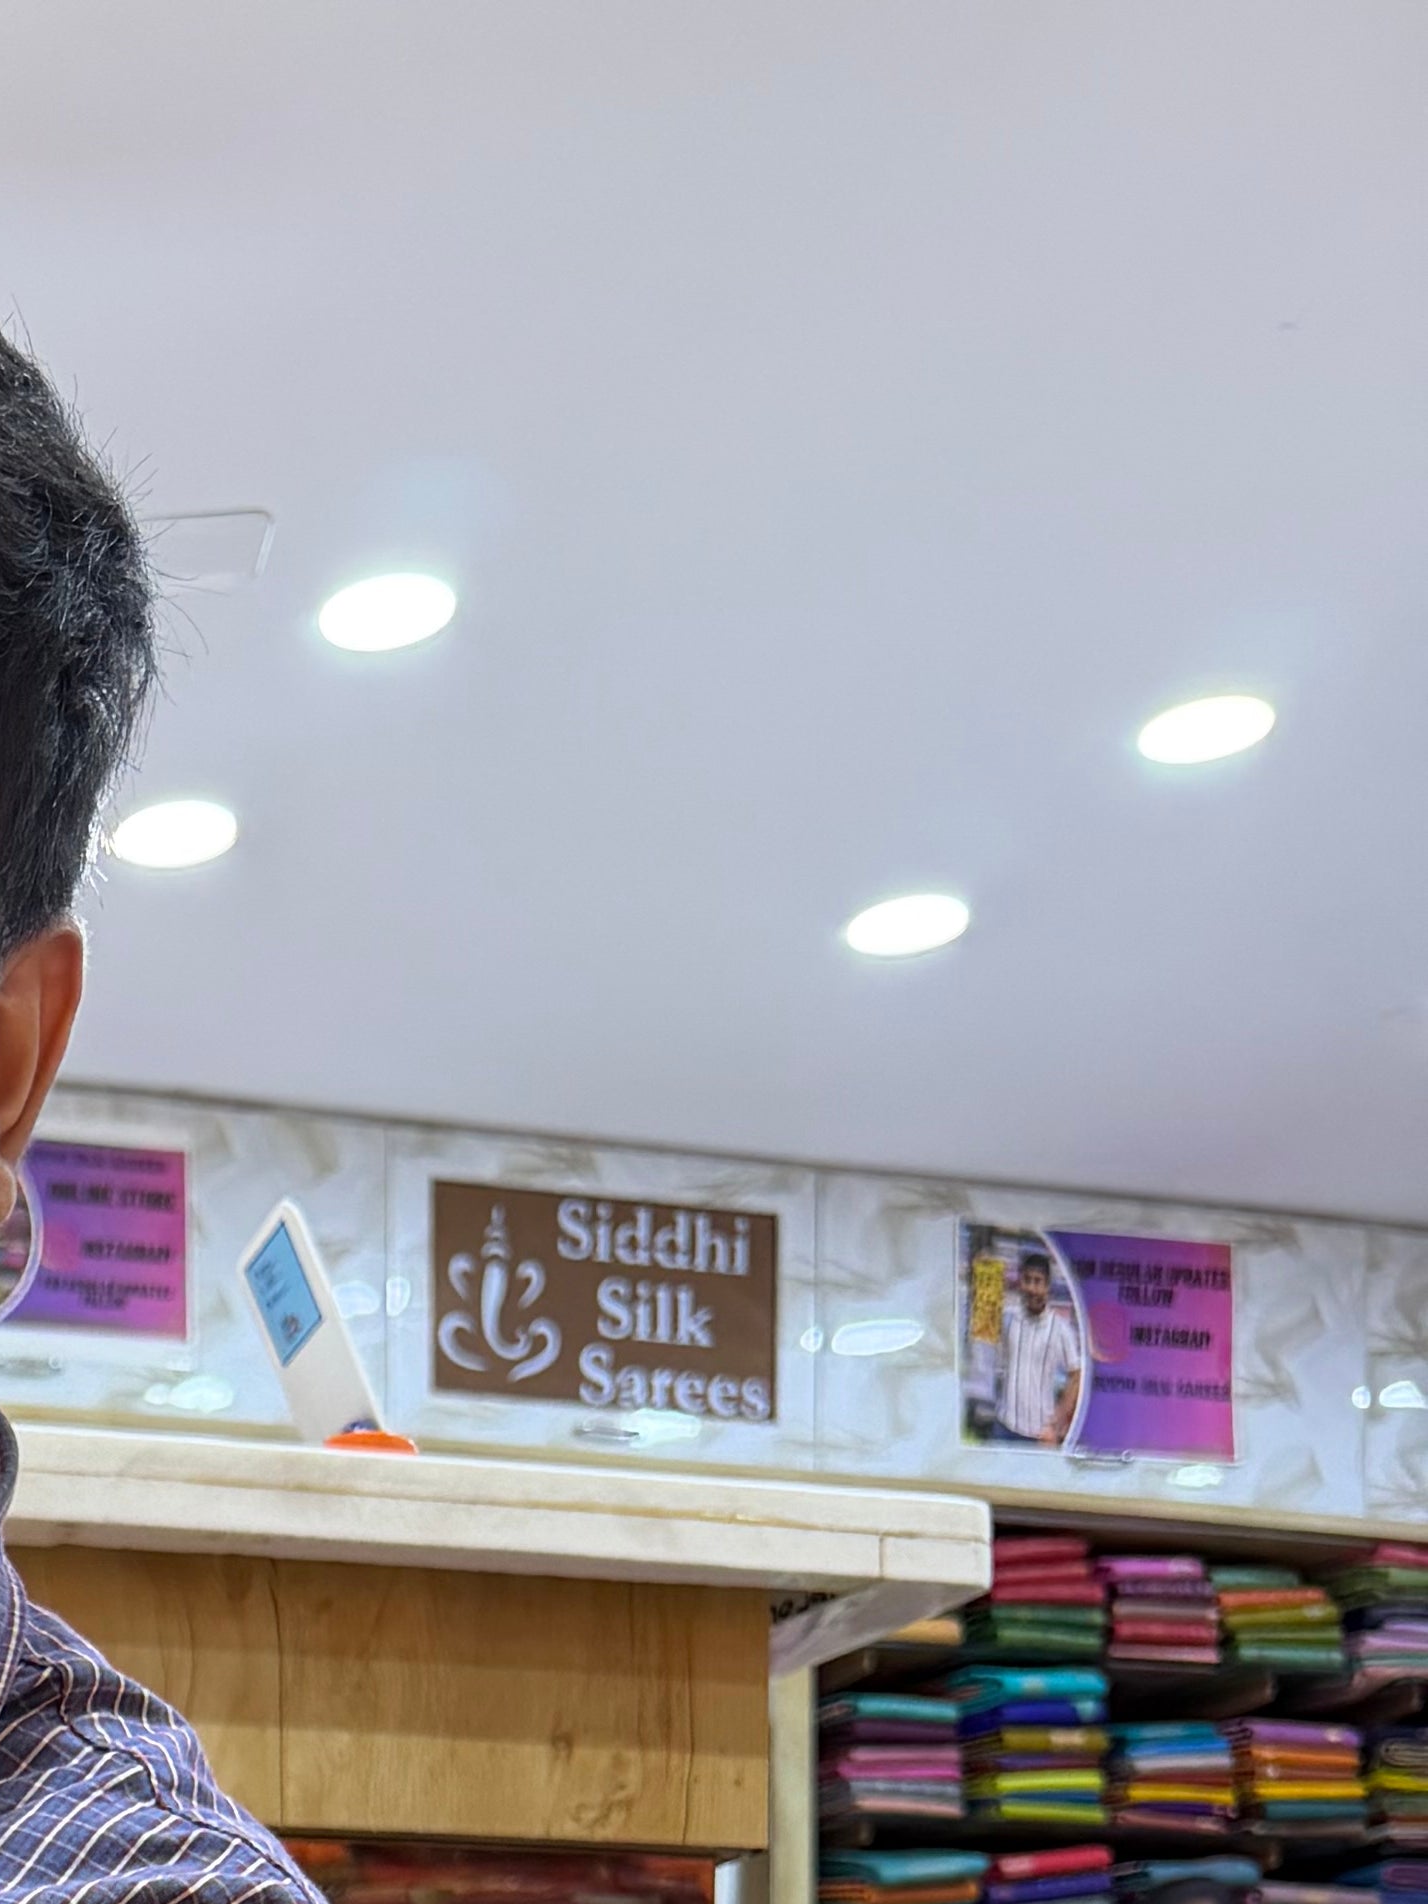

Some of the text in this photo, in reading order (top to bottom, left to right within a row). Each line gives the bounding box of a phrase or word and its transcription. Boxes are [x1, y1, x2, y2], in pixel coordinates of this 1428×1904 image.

[557, 1198, 751, 1276] Siddhi
[597, 1276, 715, 1348] Silk
[579, 1343, 771, 1421] Sarees
